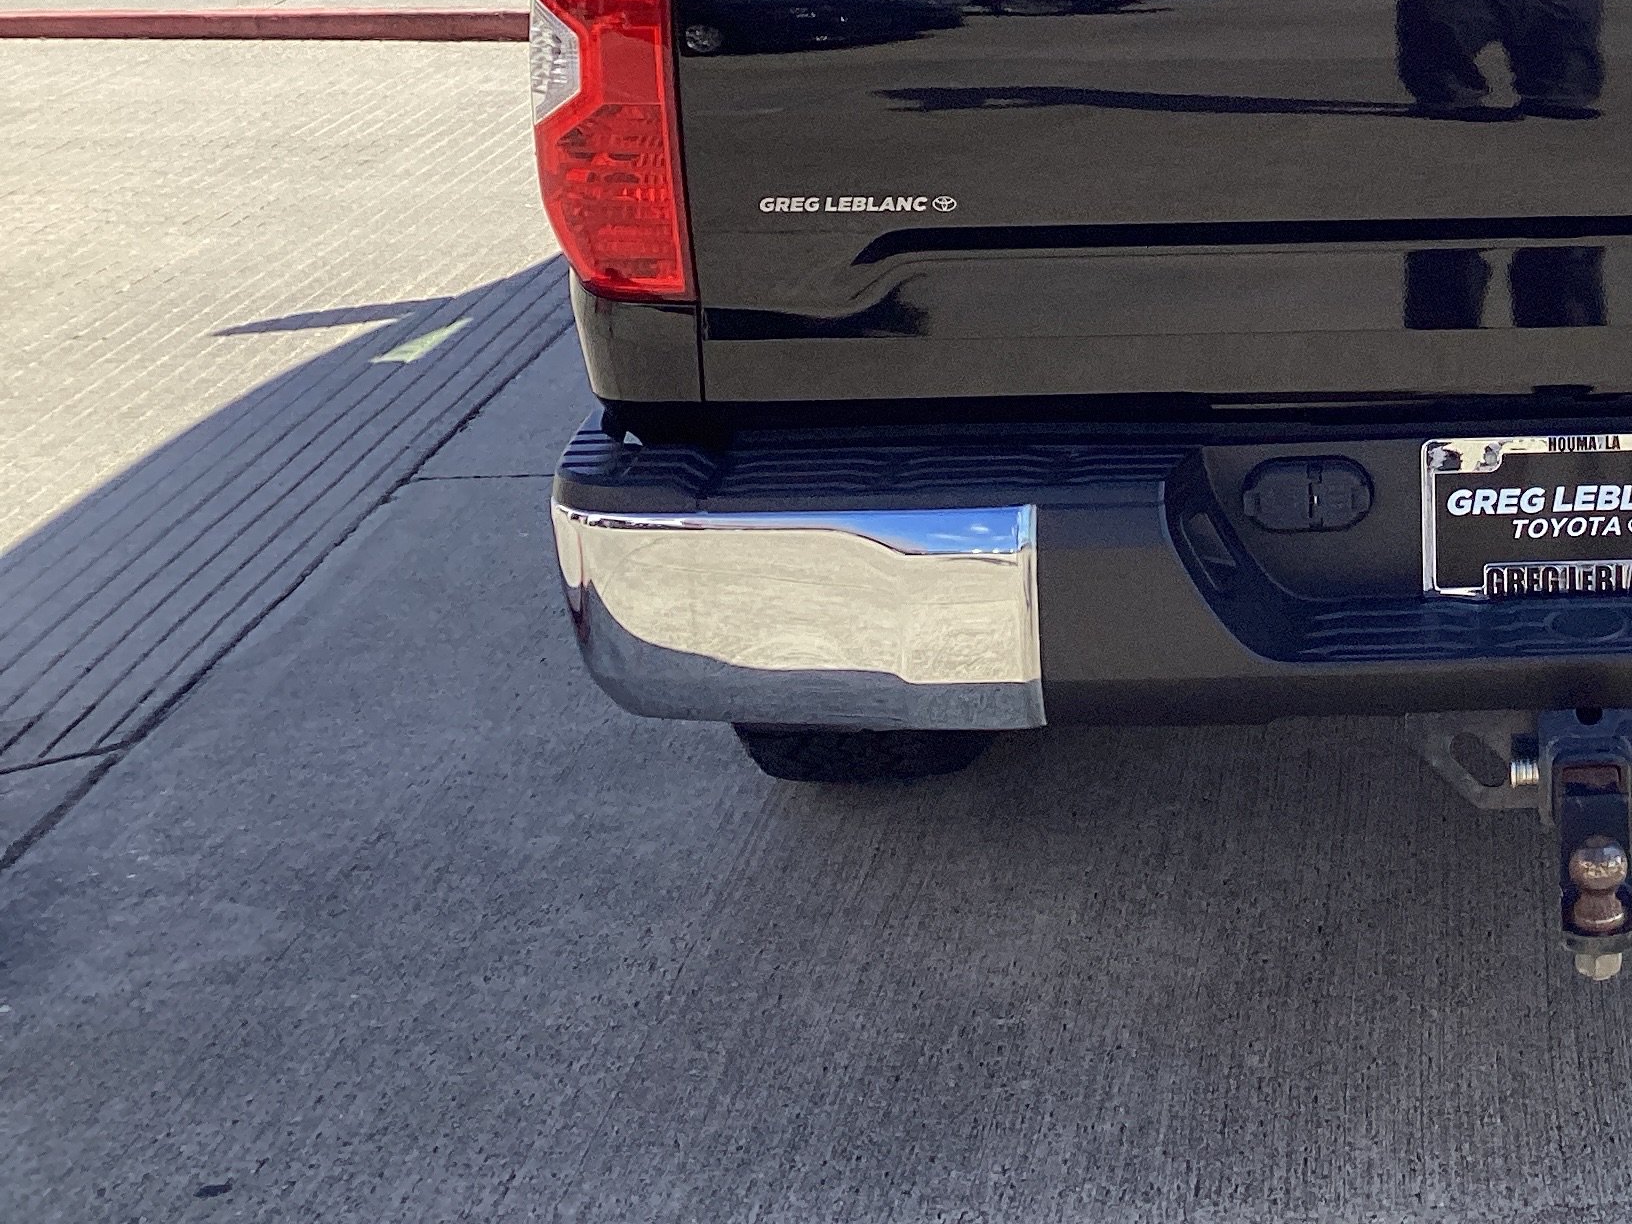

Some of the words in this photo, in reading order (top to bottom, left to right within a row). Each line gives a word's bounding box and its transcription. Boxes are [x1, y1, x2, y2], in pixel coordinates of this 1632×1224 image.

[758, 196, 820, 212] GREG
[824, 196, 928, 212] LEBLANC
[1605, 435, 1621, 450] LA
[1446, 486, 1546, 517] GREG
[1511, 516, 1622, 539] TOYOTA
[1486, 566, 1560, 597] GREG
